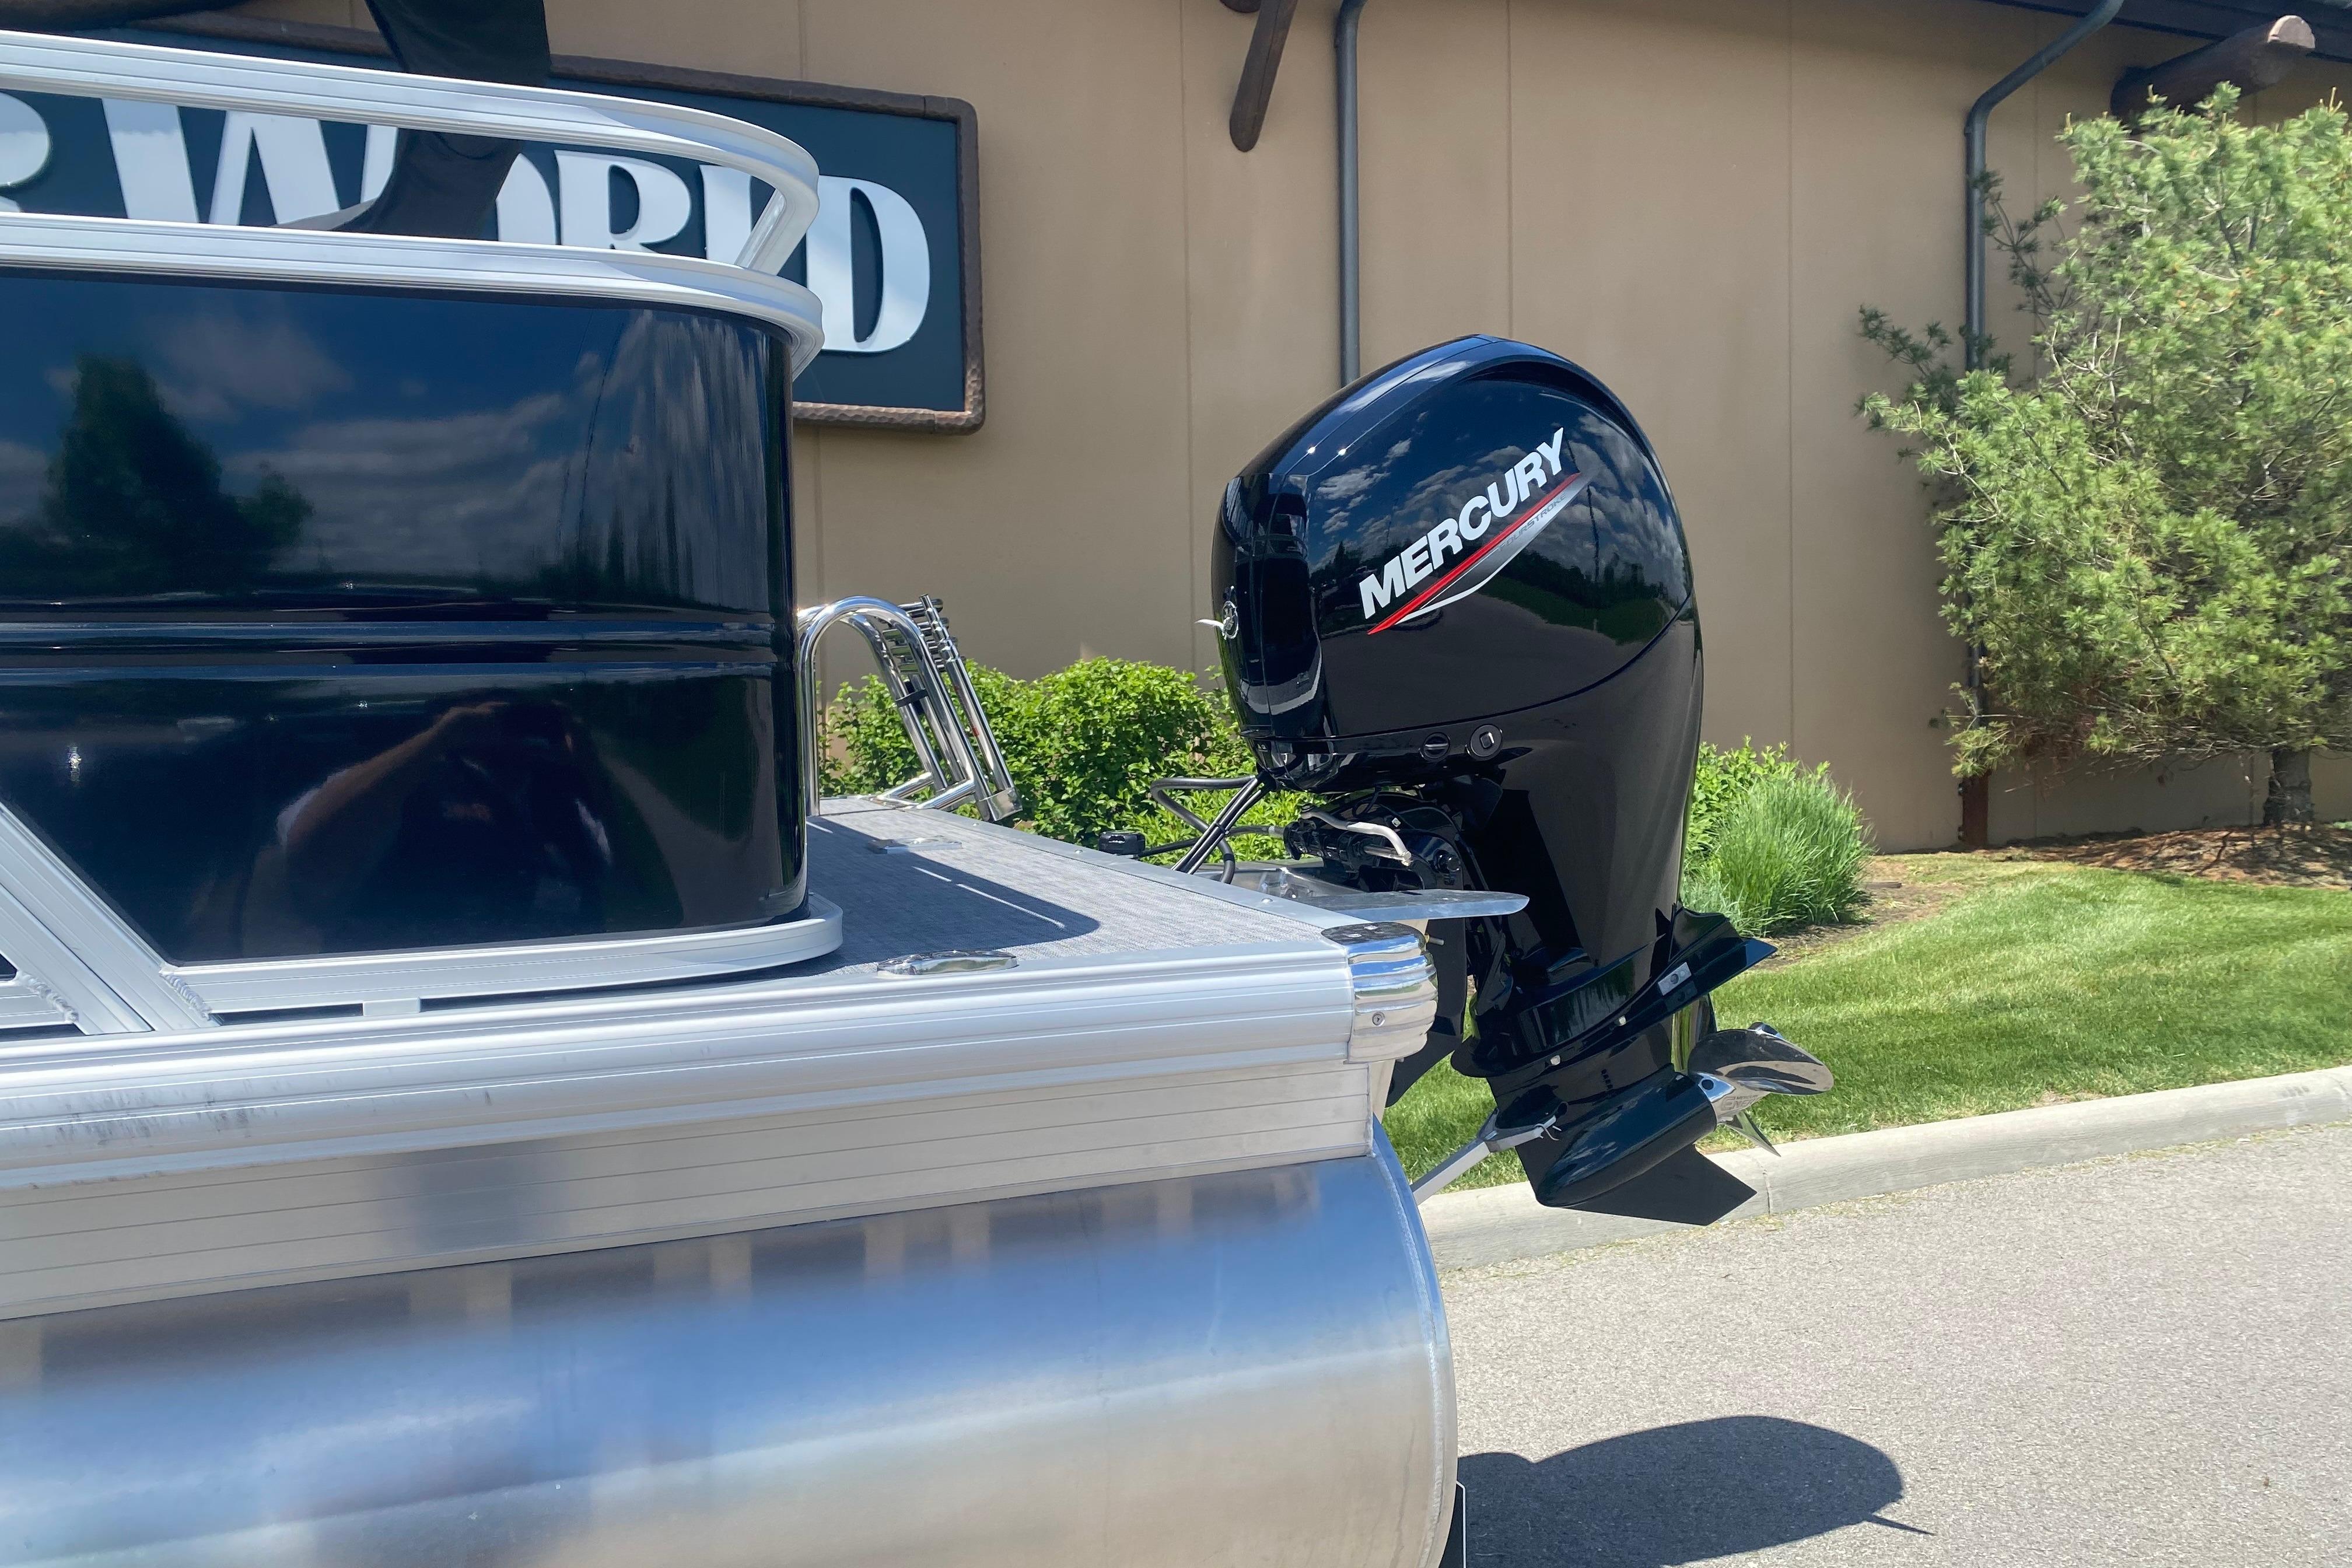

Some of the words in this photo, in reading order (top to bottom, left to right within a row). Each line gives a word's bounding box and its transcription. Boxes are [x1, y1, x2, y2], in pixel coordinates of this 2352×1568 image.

[102, 97, 930, 352] WRD
[1359, 427, 1564, 619] MERCURY
[1497, 491, 1566, 551] FOURSTROKE
